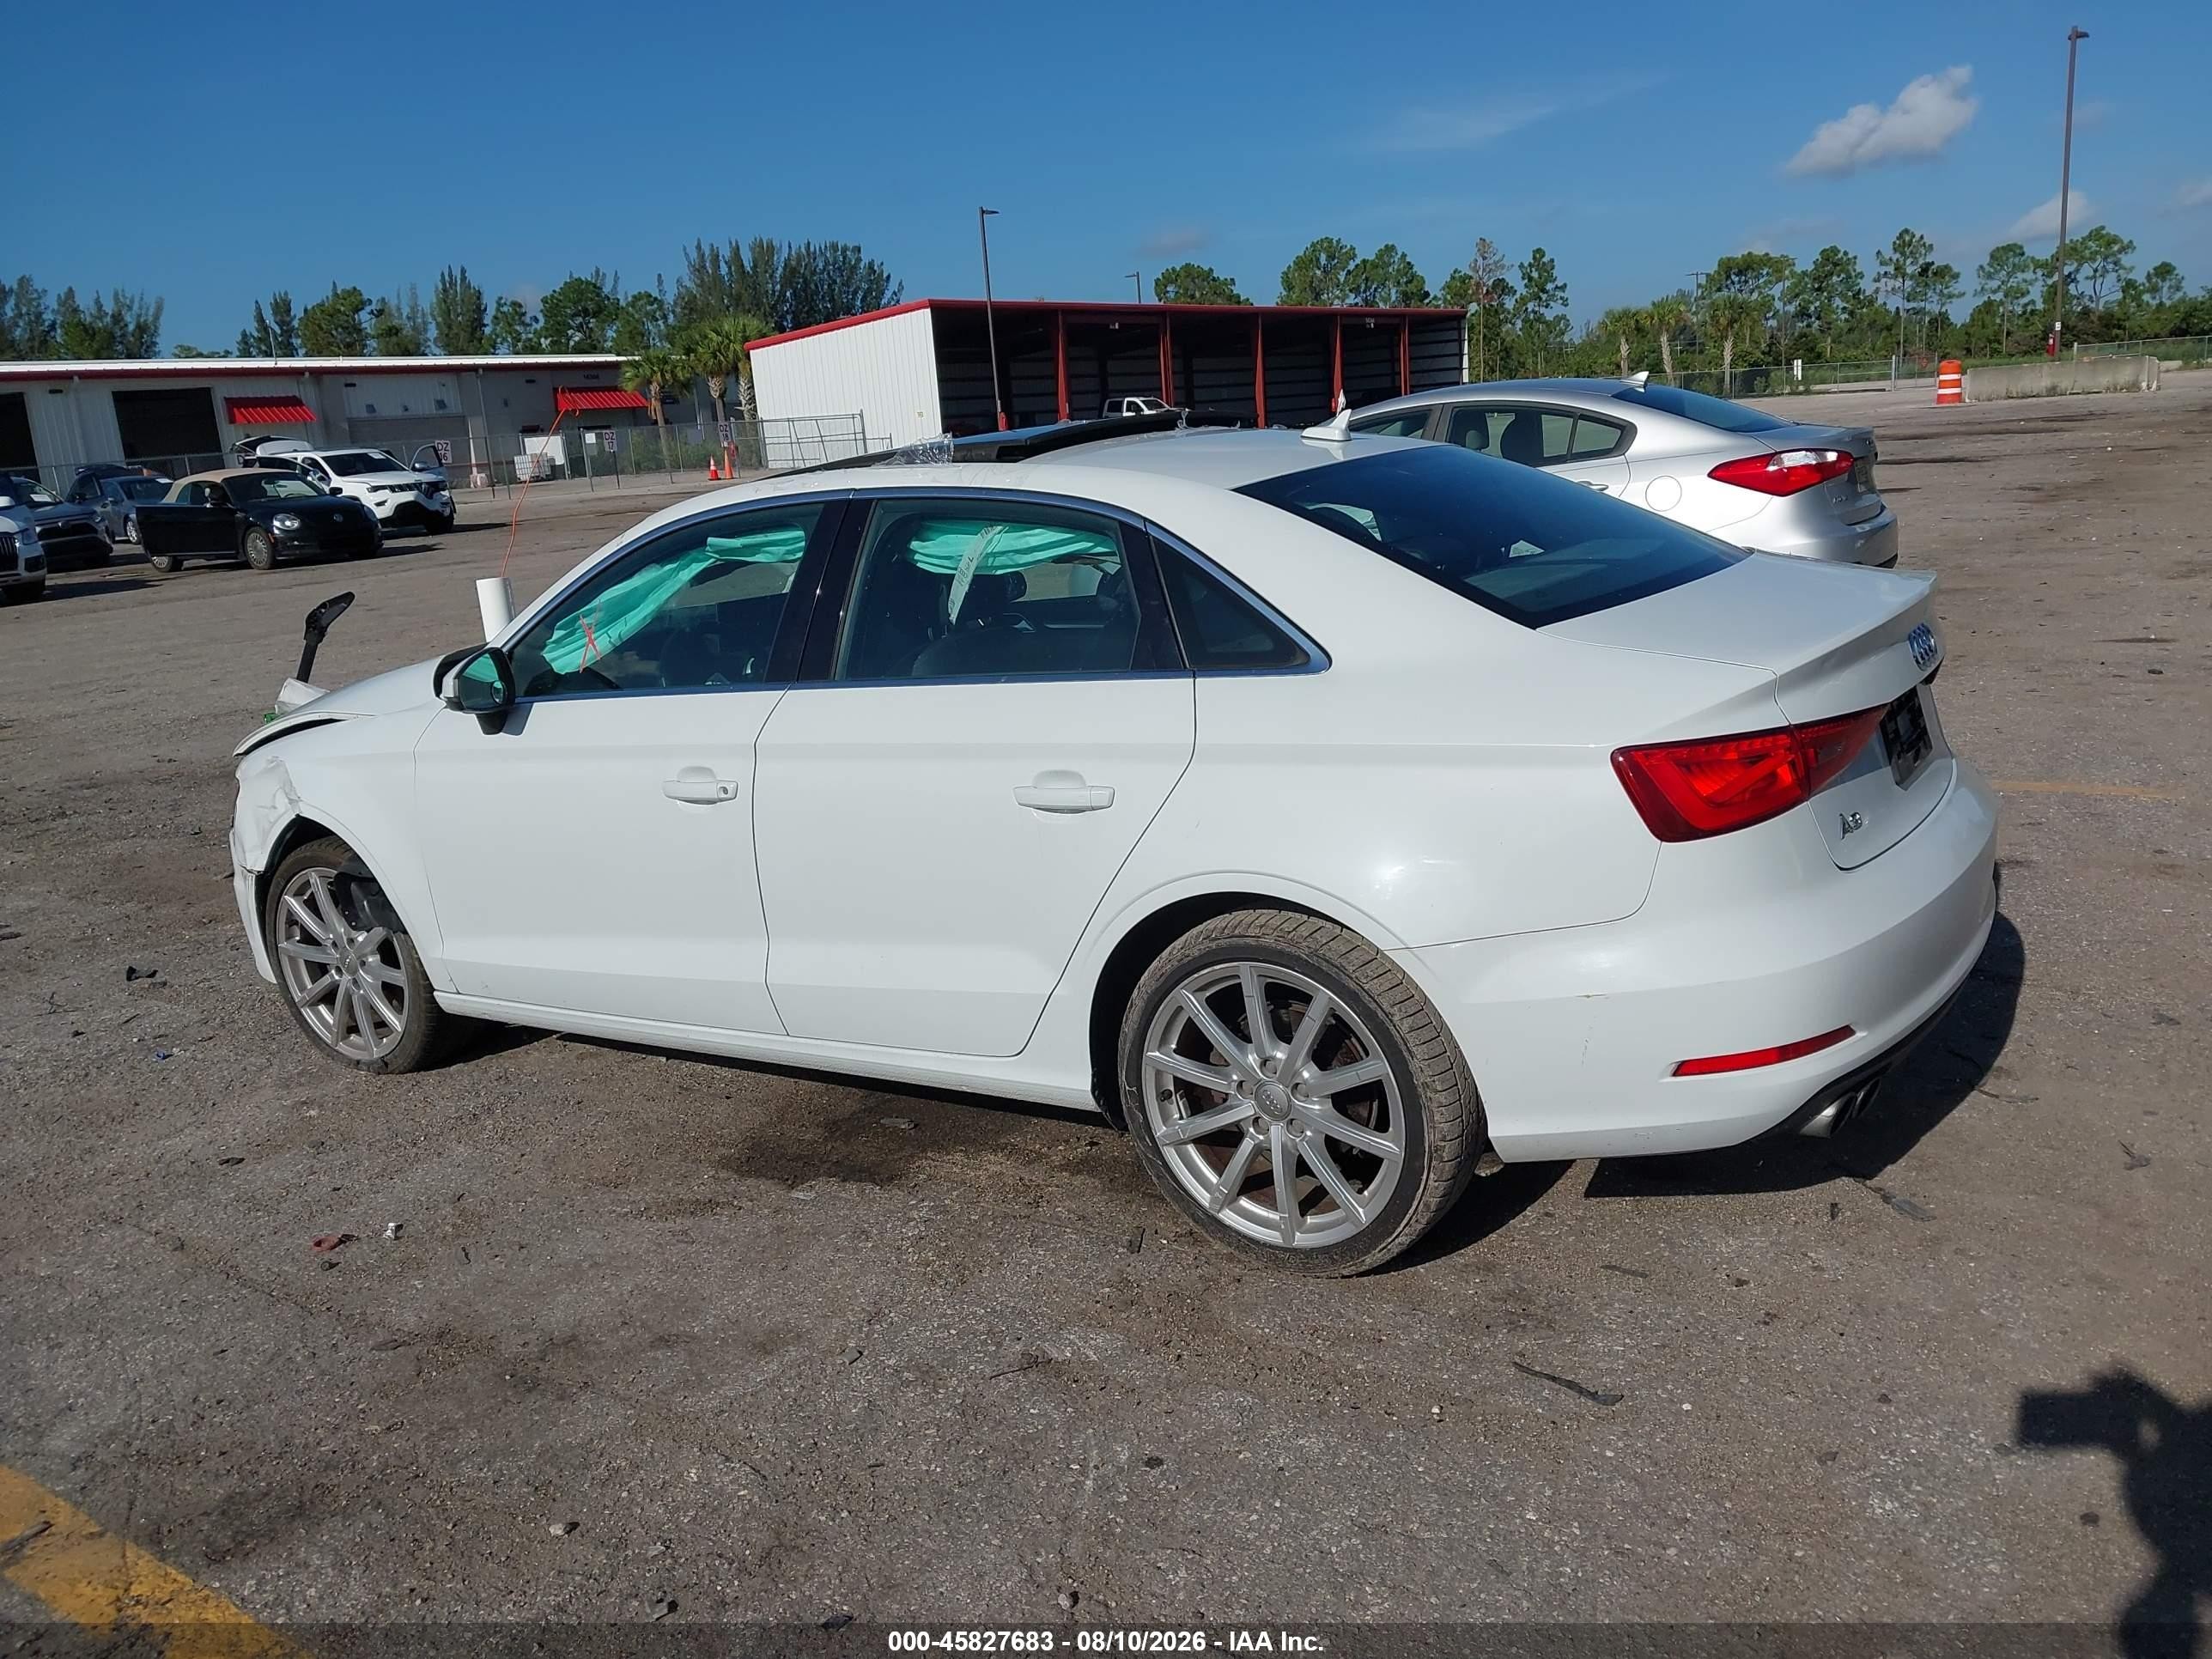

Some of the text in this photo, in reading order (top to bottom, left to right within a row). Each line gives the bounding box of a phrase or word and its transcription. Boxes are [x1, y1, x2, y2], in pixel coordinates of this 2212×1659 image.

[437, 441, 449, 452] DZ
[608, 441, 613, 450] 17
[439, 453, 447, 461] 16
[1839, 811, 1863, 840] A3
